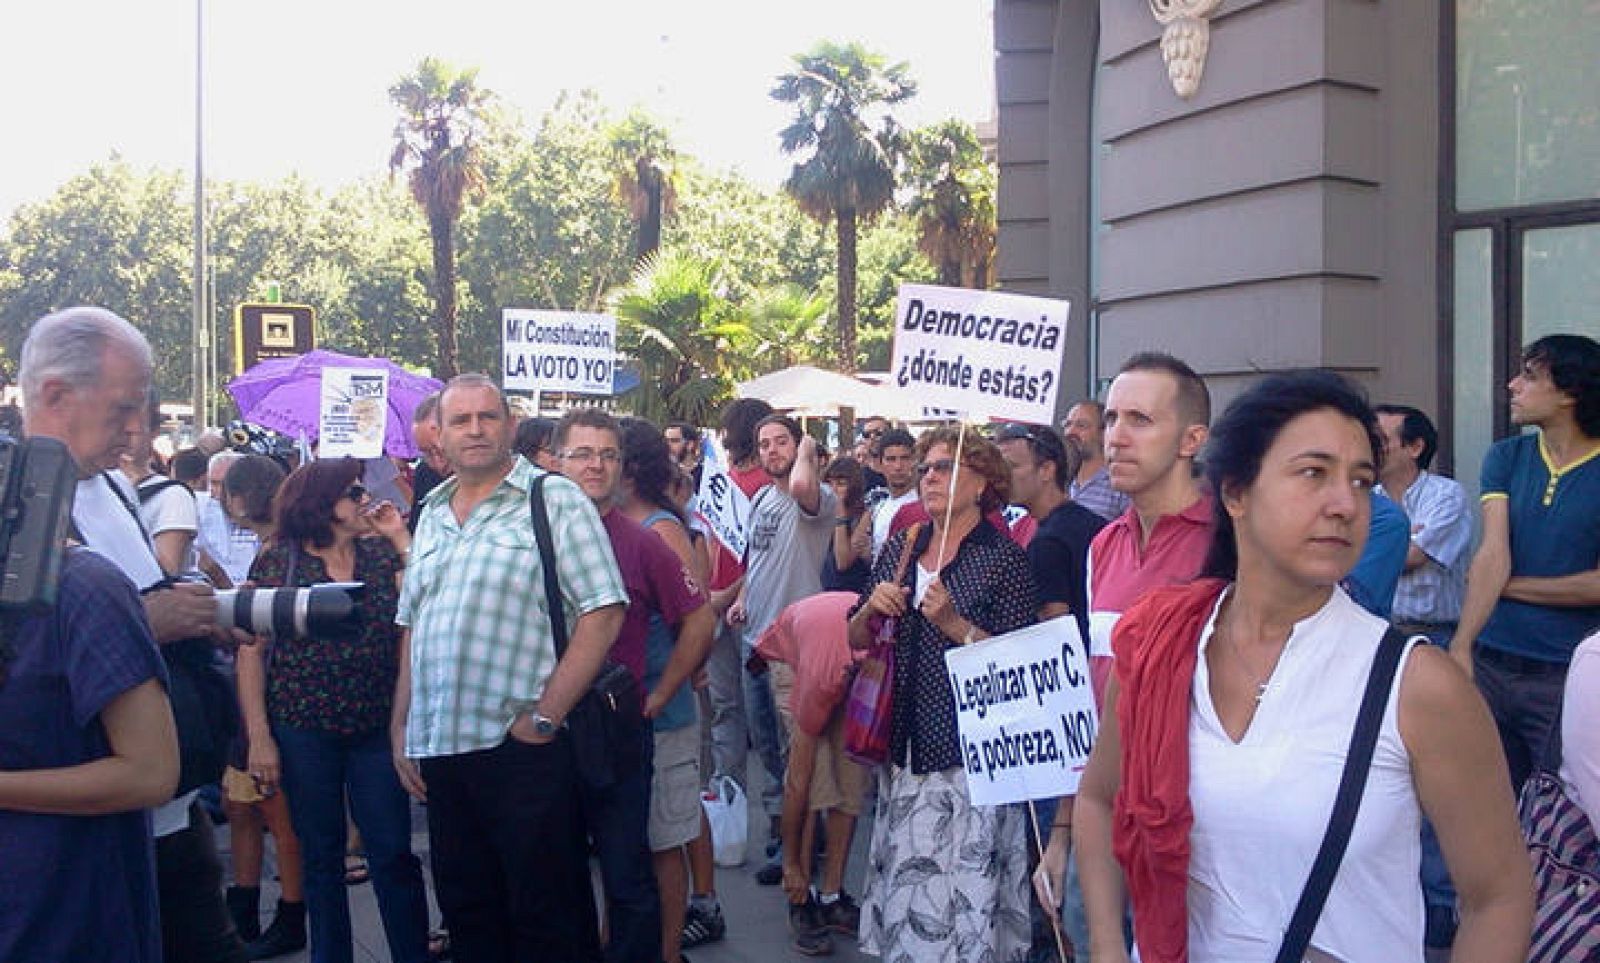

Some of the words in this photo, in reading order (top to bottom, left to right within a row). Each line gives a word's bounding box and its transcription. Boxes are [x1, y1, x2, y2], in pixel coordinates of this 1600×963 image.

[506, 319, 522, 342] Mi
[903, 299, 1060, 350] Democracia
[506, 354, 528, 377] LA
[531, 355, 579, 380] VOTO
[583, 358, 612, 383] YO!
[897, 348, 972, 390] ¿dónde
[977, 365, 1053, 404] estás?
[952, 660, 1027, 719] Legalizar
[1029, 657, 1061, 707] por
[1061, 642, 1085, 687] C.
[961, 733, 983, 775] la
[981, 724, 1065, 783] pobreza,
